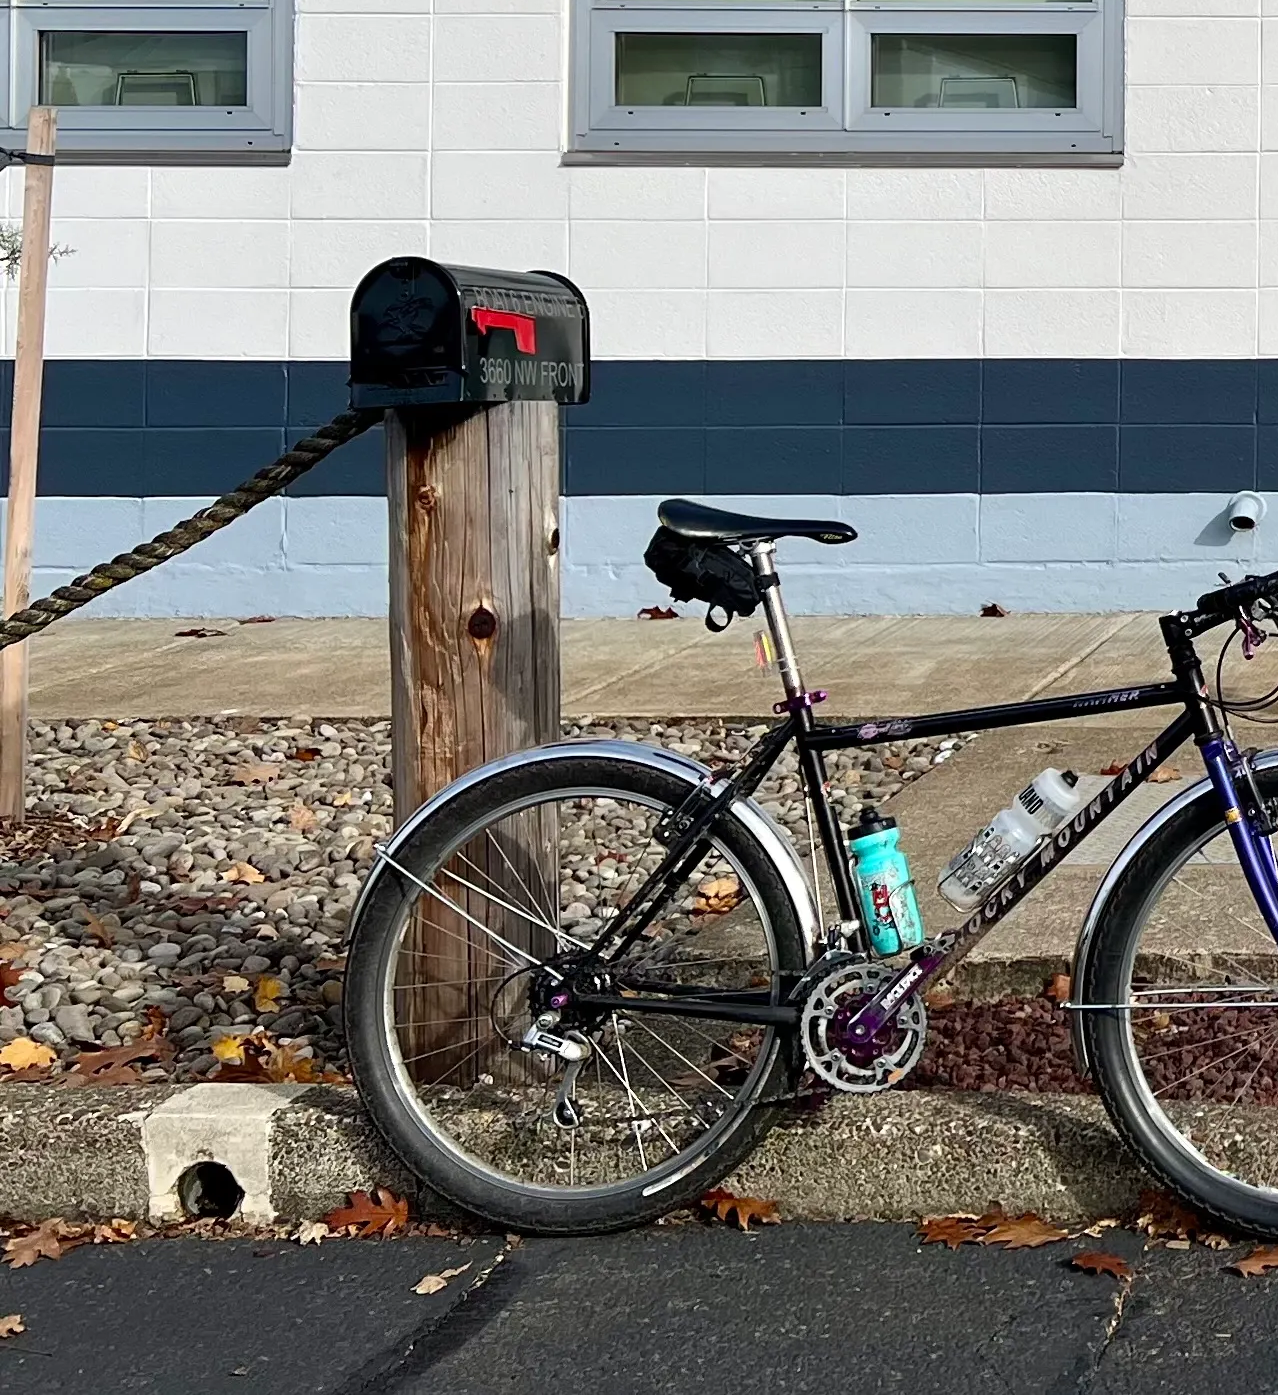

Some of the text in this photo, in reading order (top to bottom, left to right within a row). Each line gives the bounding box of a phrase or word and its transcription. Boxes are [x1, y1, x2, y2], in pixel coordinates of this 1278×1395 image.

[521, 291, 575, 318] ENGINE
[480, 357, 584, 387] 3660 NW FRONT
[1040, 740, 1158, 868] MOUNTAIN
